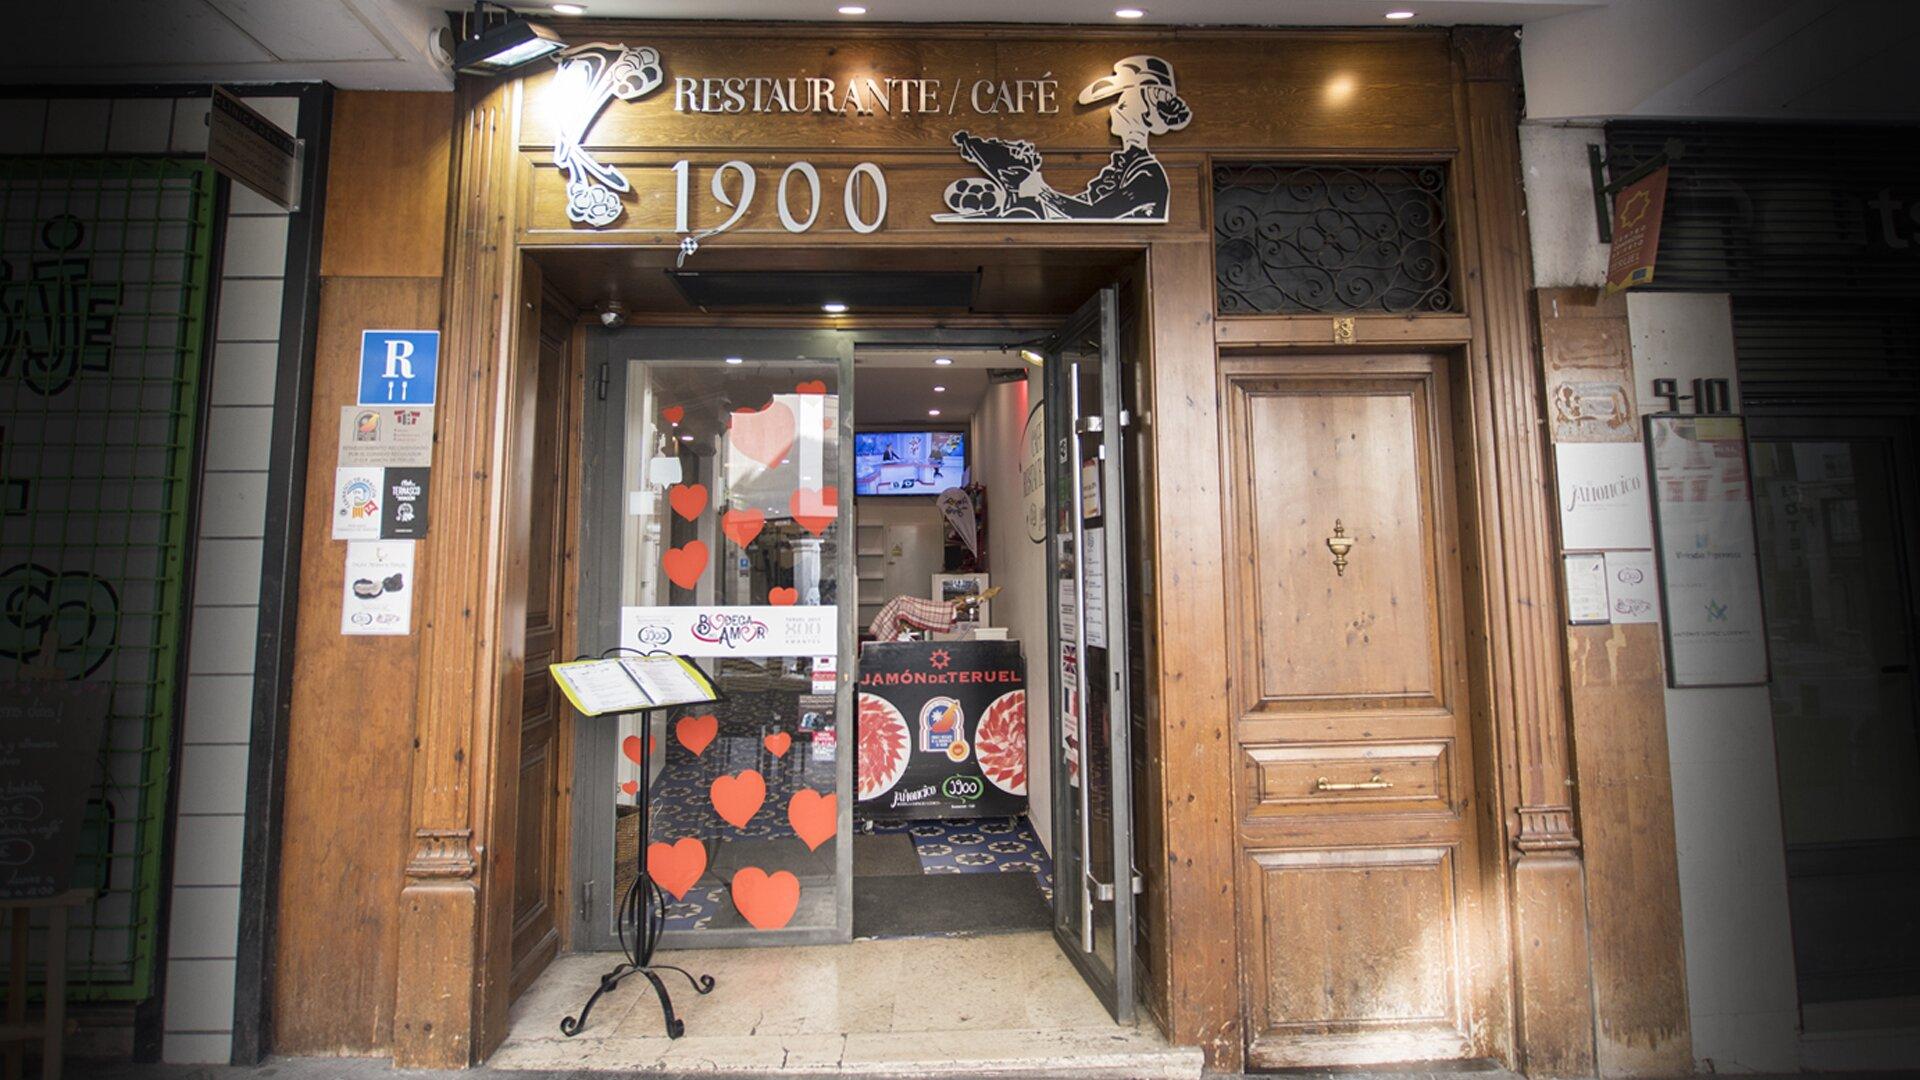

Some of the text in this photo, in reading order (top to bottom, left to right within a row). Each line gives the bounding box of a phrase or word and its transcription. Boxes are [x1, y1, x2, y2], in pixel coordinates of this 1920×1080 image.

[674, 76, 941, 115] RESTAURANTE
[971, 72, 1060, 115] CAFÉ
[671, 160, 888, 268] 1900
[381, 339, 416, 379] R
